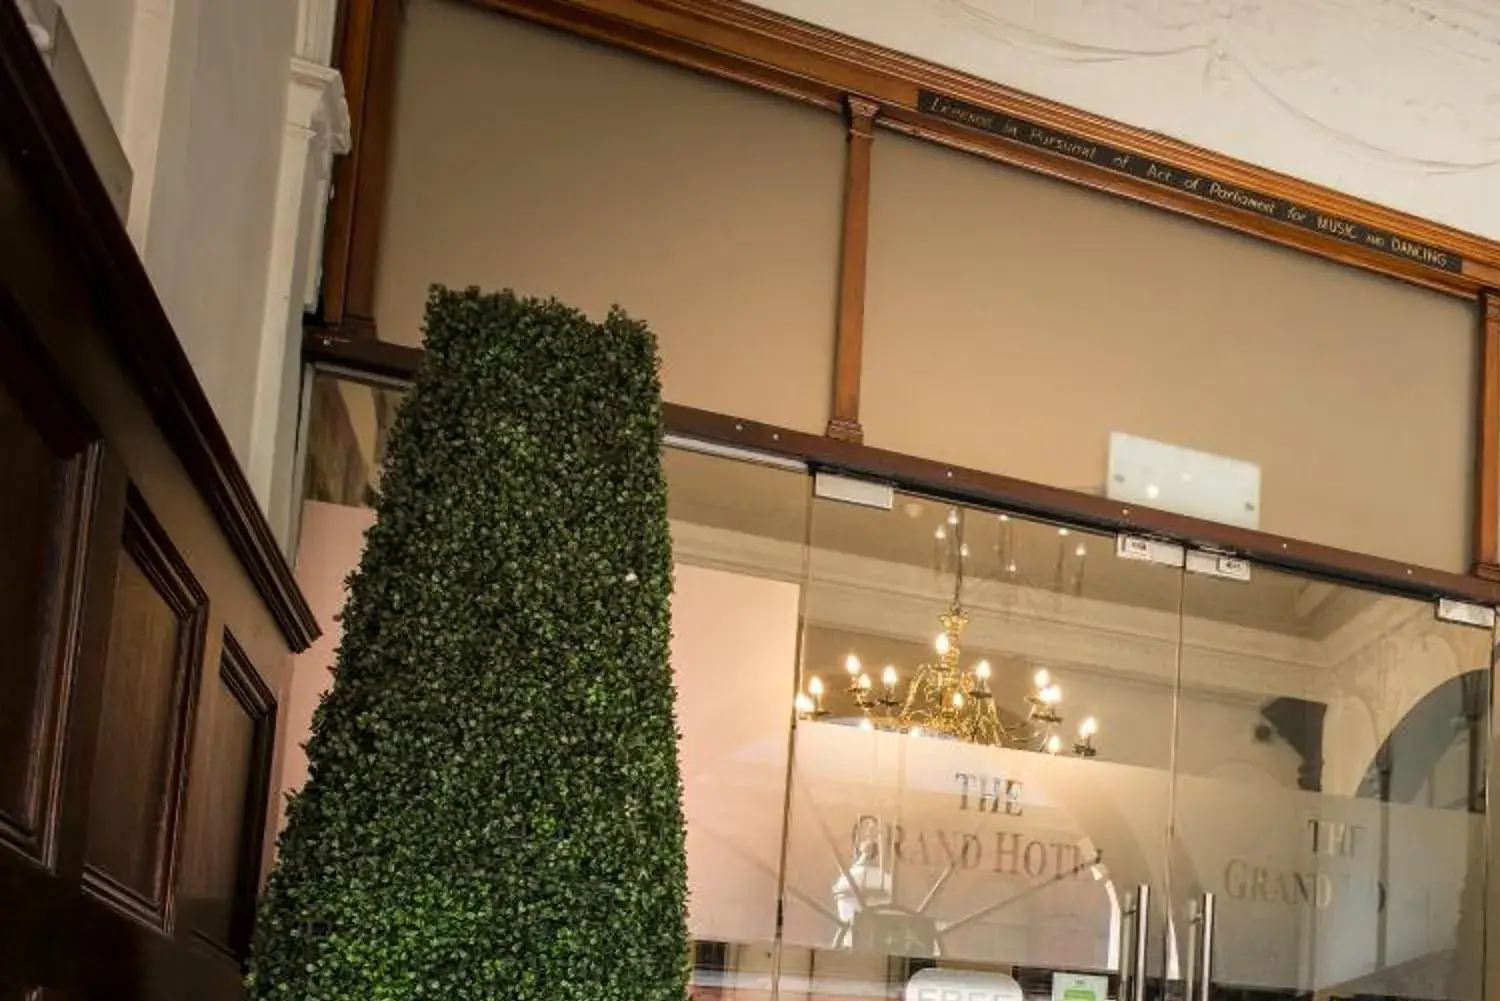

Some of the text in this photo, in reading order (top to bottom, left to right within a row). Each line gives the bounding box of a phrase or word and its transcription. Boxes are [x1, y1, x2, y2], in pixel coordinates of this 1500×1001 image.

[1003, 121, 1018, 138] in
[1111, 156, 1130, 170] of
[1146, 163, 1173, 183] Act
[1183, 172, 1201, 191] of
[1209, 182, 1275, 216] Parliament
[1287, 206, 1307, 222] for
[1316, 215, 1357, 240] MUSIC
[1365, 234, 1386, 248] AND
[1391, 238, 1448, 267] DANCING
[955, 771, 1024, 817] THE
